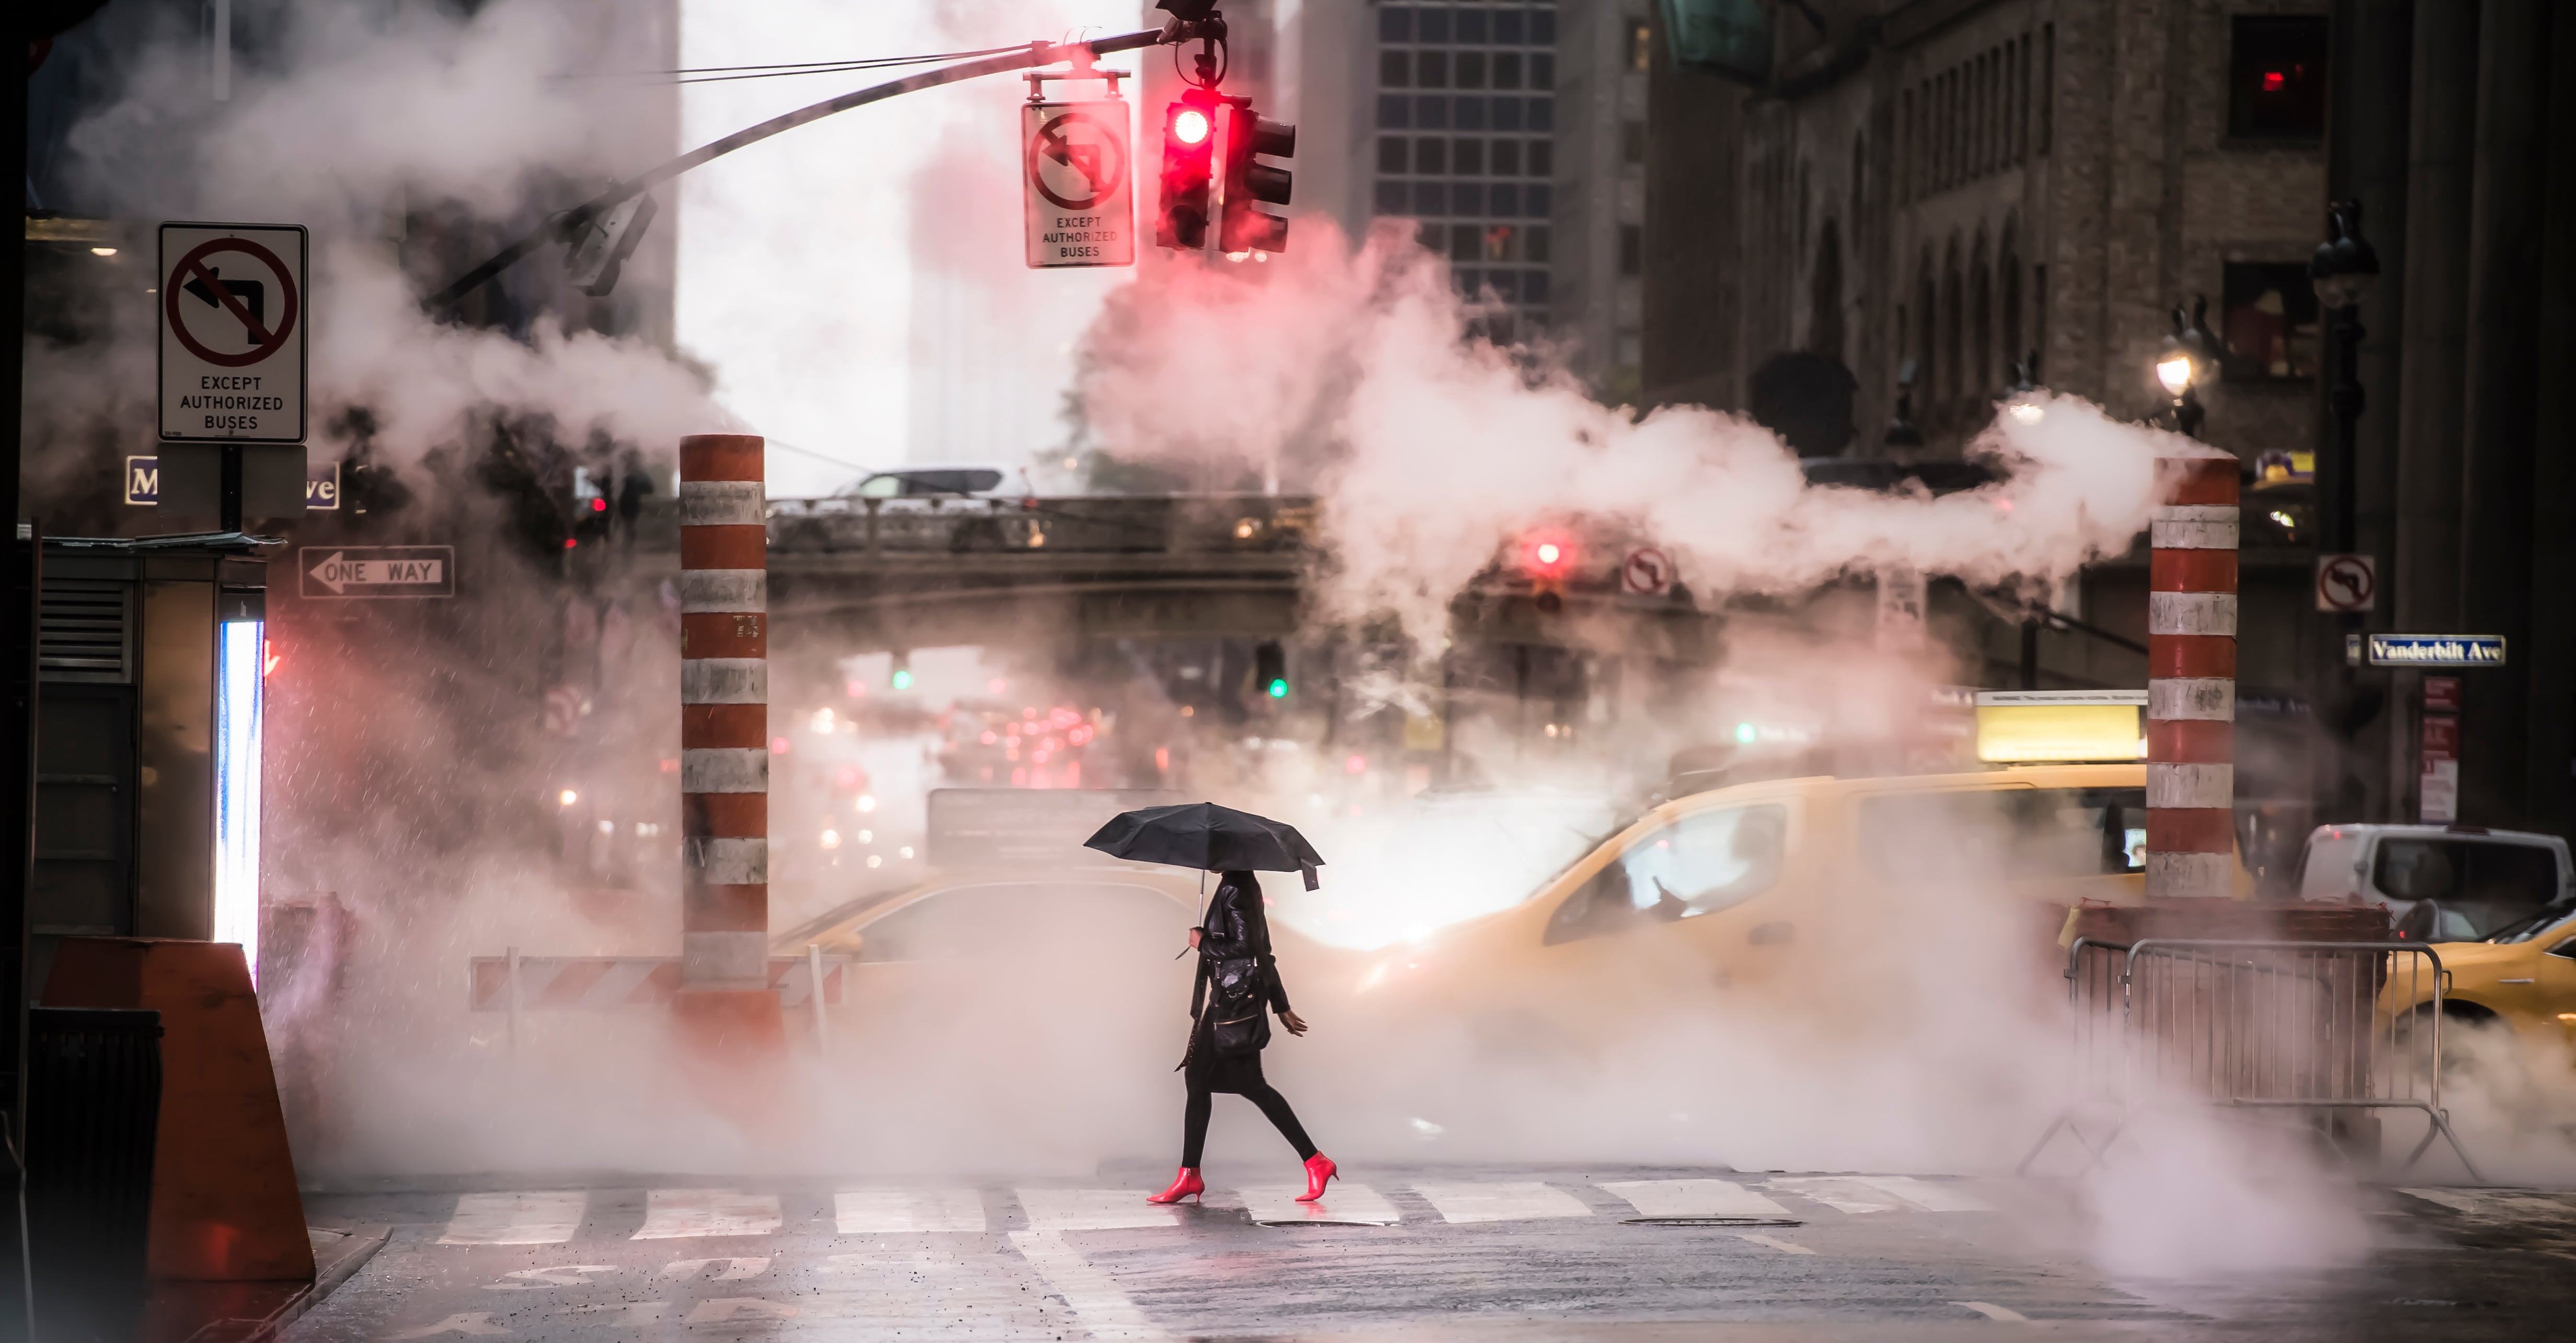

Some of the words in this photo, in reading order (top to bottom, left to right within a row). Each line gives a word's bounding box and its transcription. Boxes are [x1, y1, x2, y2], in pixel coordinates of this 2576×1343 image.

[1057, 216, 1101, 228] EXCEPT
[1042, 231, 1118, 243] AUTHORIZED
[1060, 246, 1099, 257] BUSES
[201, 376, 261, 391] EXCEPT
[180, 395, 283, 410] AUTHORIZED
[205, 416, 258, 429] BUSES
[306, 480, 335, 500] ve
[325, 563, 366, 581] ONE
[387, 563, 432, 581] WAY
[2373, 640, 2464, 660] Vanderbilt
[2468, 641, 2501, 660] Ave
